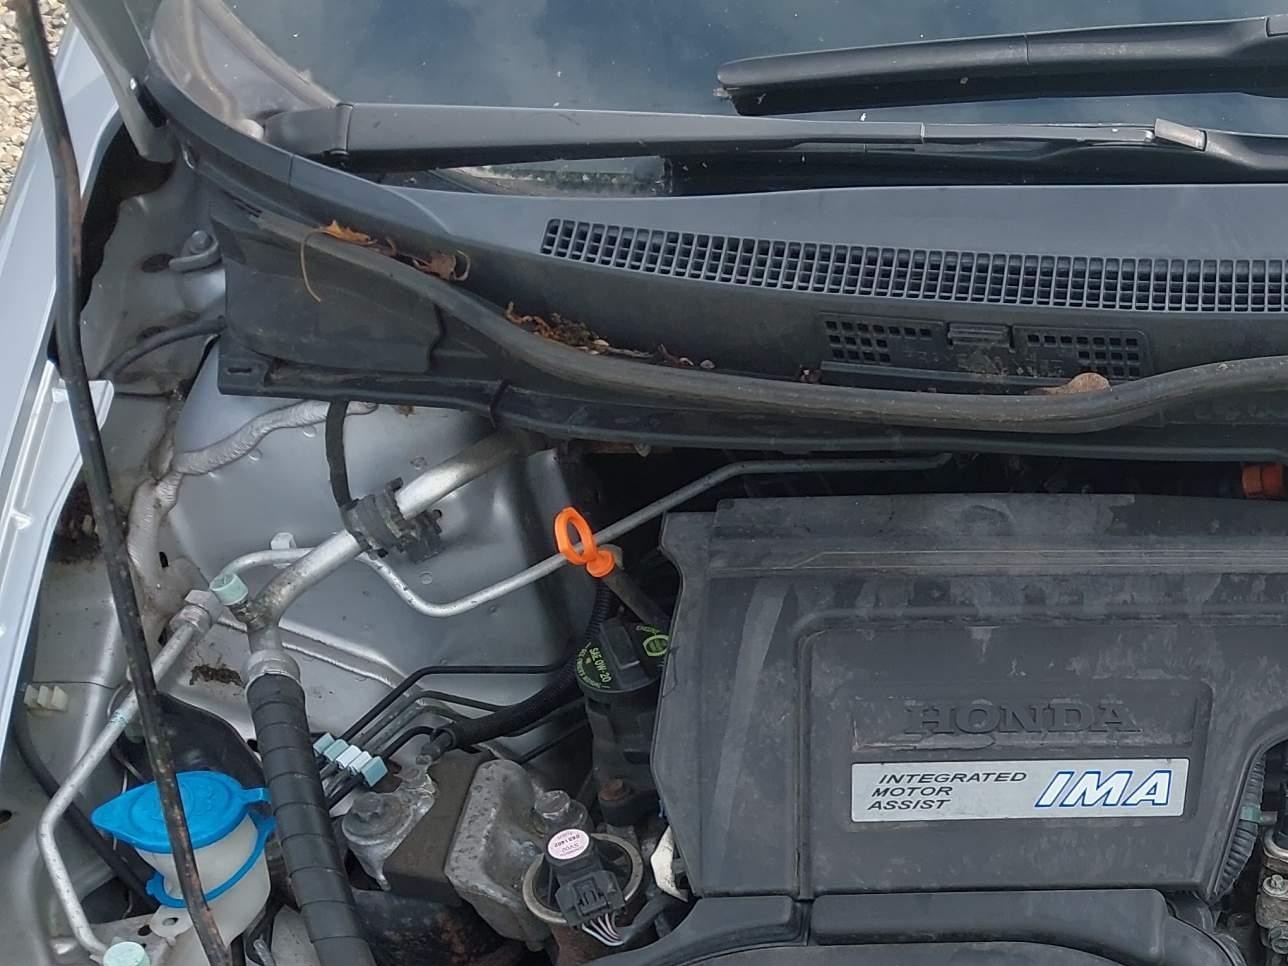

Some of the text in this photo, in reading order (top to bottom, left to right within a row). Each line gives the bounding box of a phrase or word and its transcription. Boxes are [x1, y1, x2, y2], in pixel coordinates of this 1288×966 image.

[589, 647, 602, 662] SAE
[904, 703, 1144, 735] HONDA
[879, 772, 1027, 785] INTEGRATED
[871, 786, 954, 798] MOTOR
[1034, 769, 1173, 808] IMA
[867, 799, 952, 812] ASSIST
